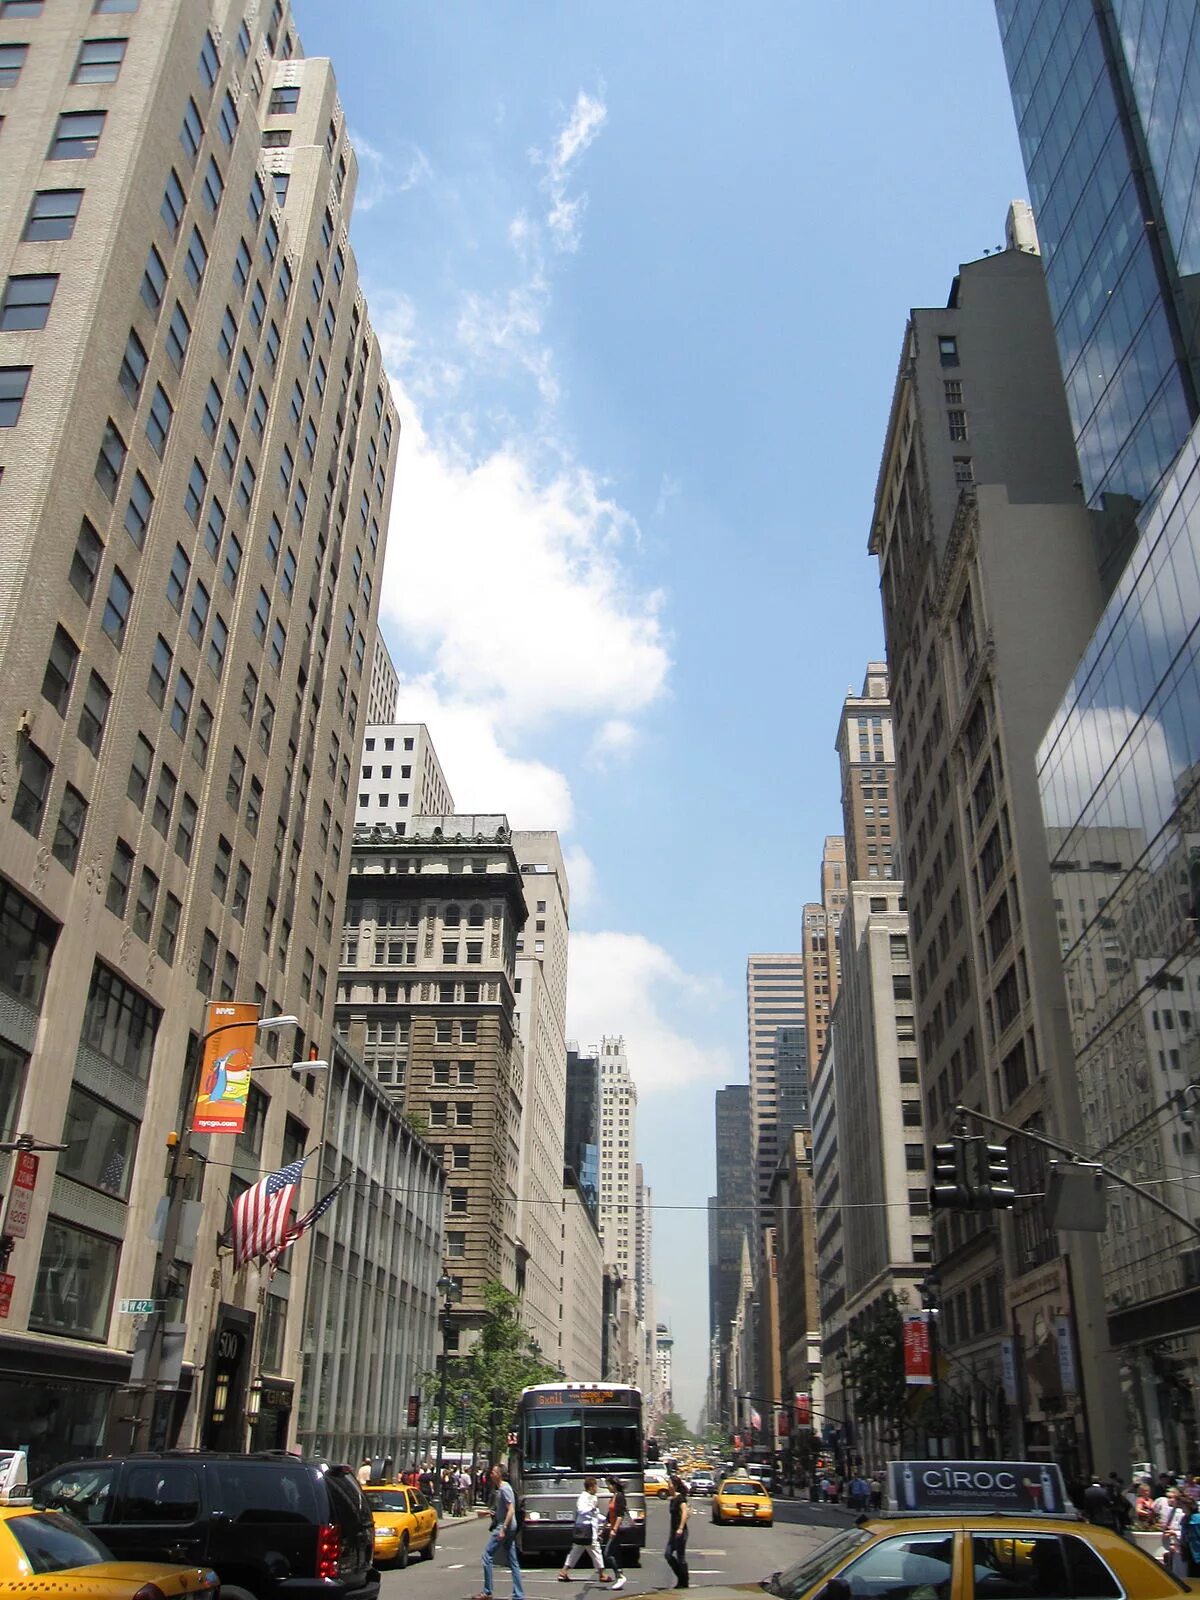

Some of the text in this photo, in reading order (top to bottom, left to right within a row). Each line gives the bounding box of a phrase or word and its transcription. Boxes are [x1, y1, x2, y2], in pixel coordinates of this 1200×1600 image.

[215, 1007, 236, 1015] NYC
[198, 1119, 238, 1128] nycgo.com
[904, 1322, 914, 1346] World
[912, 1332, 921, 1362] Science
[923, 1467, 1016, 1489] CÎROC
